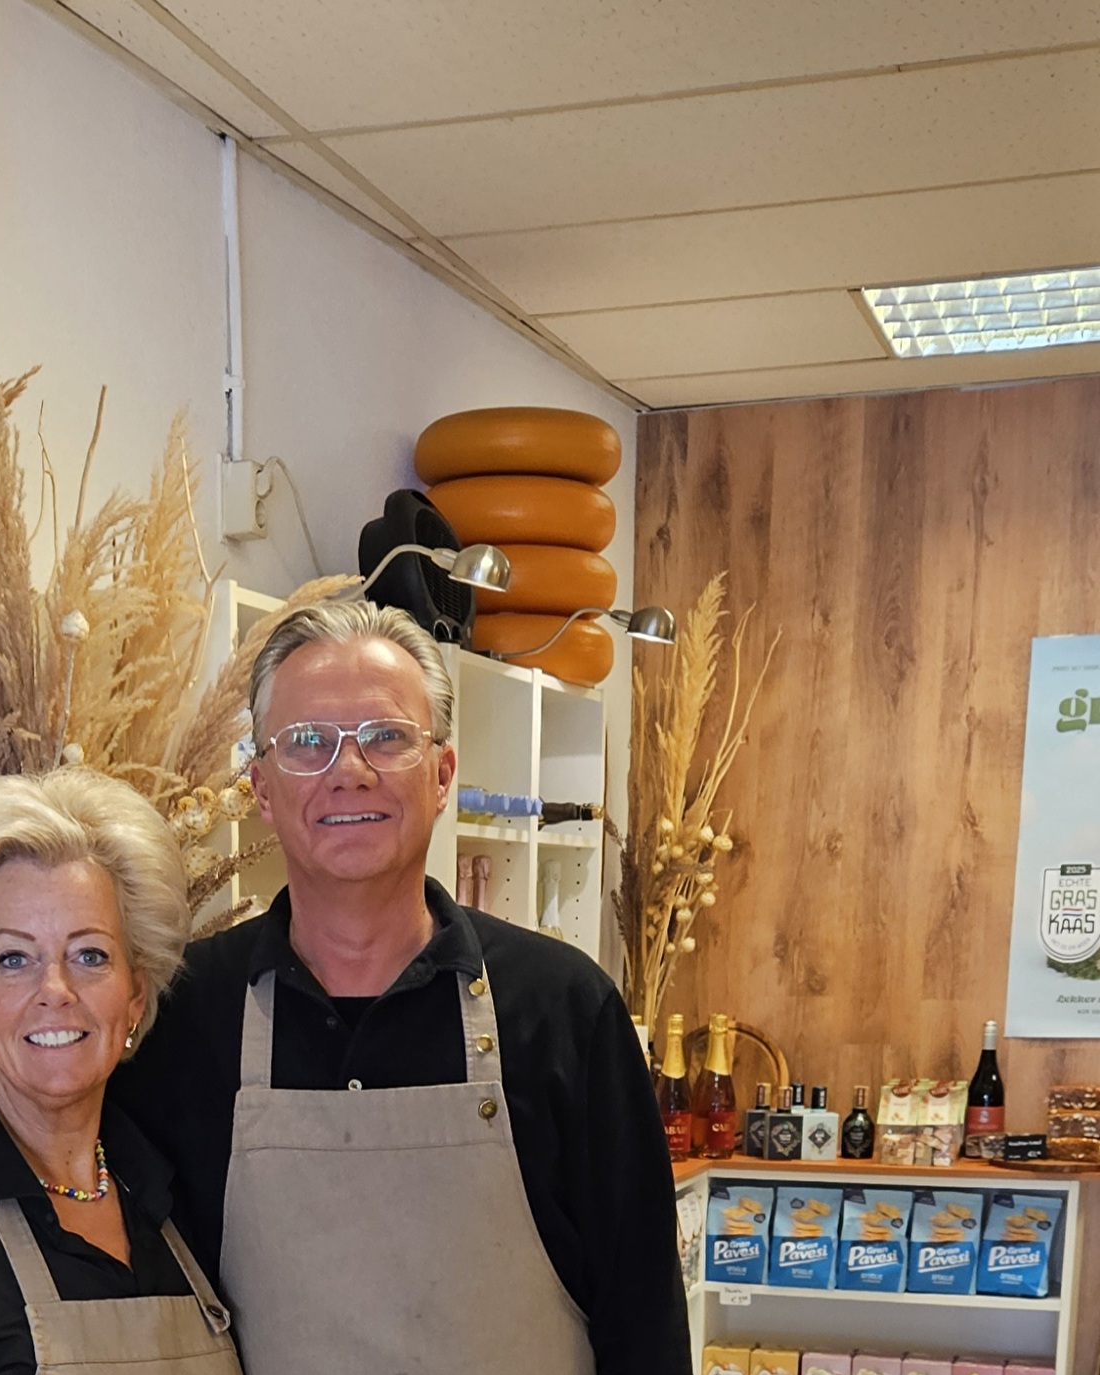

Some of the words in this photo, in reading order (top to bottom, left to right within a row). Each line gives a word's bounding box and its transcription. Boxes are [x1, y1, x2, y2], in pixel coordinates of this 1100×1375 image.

[1059, 878, 1092, 887] ECHTE
[1050, 890, 1097, 910] GRAS
[1048, 914, 1095, 934] KAAS
[714, 1241, 759, 1260] Pavesi
[780, 1242, 827, 1262] Pavesi
[848, 1246, 898, 1266] Pavesi
[918, 1248, 970, 1268] Pavesi
[988, 1246, 1040, 1266] Pavesi
